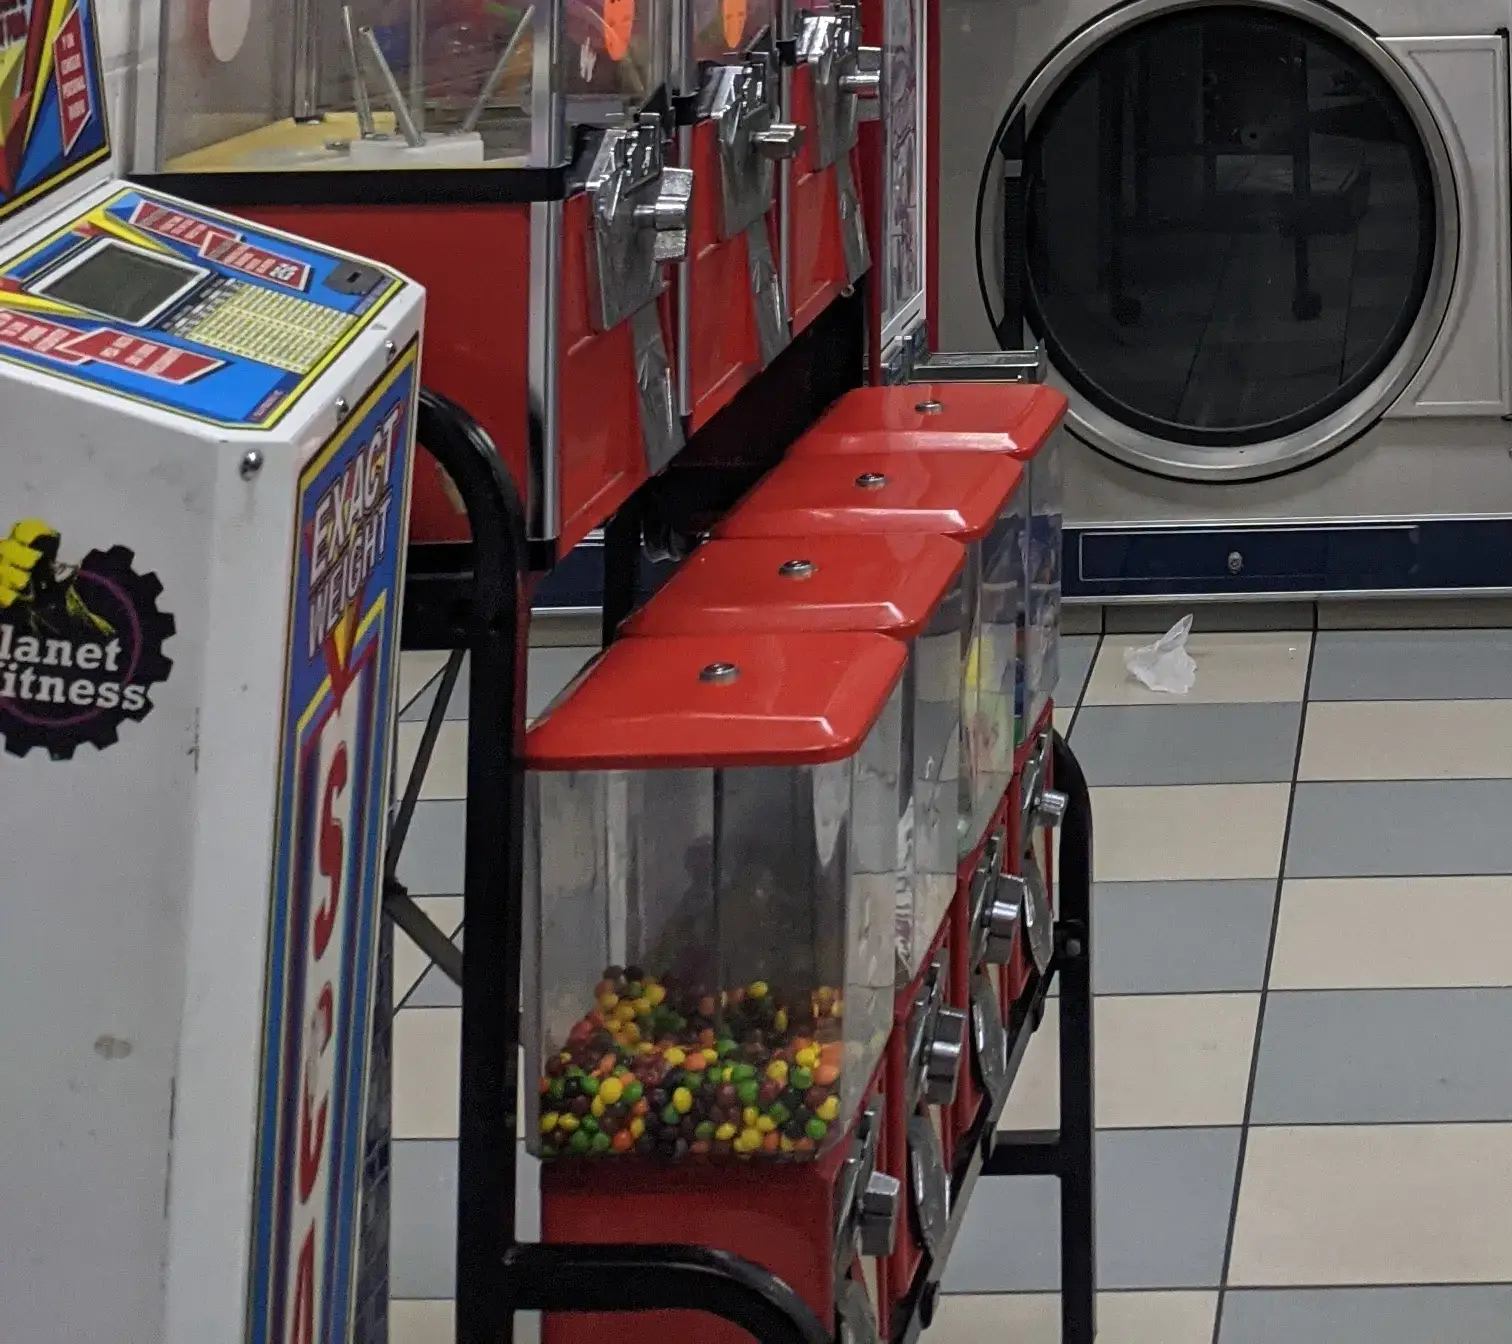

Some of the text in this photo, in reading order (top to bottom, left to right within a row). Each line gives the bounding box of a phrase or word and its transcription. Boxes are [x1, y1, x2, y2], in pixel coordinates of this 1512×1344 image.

[310, 408, 400, 589] EXACT
[308, 498, 392, 660] WEIGHT
[0, 623, 122, 672] lanet
[0, 662, 146, 711] itness
